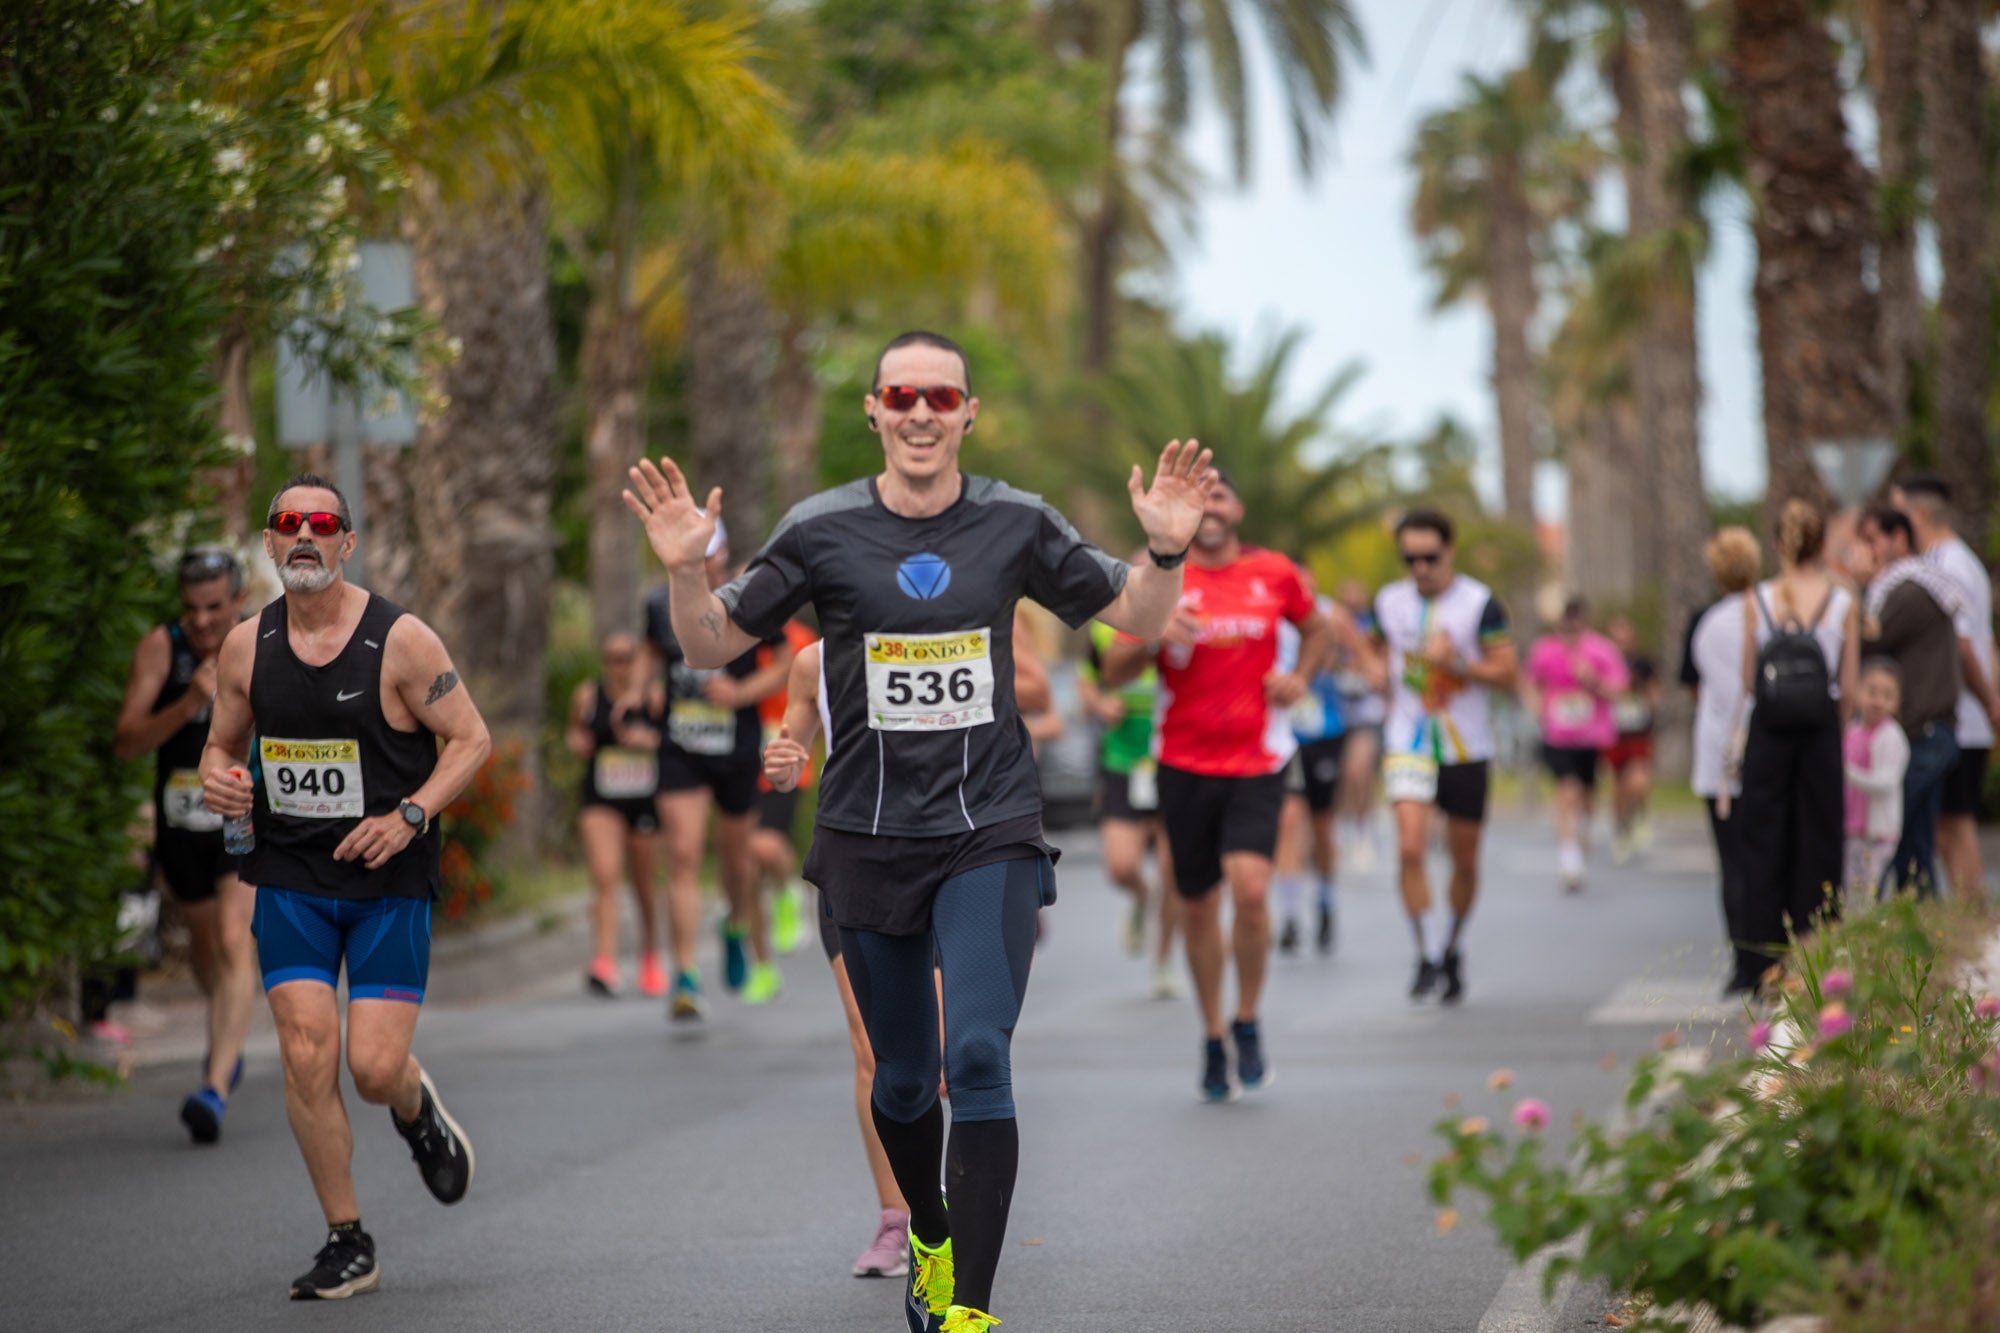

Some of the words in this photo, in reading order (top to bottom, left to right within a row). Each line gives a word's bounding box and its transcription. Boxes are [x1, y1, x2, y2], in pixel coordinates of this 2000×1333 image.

[883, 641, 904, 658] 38
[886, 667, 975, 706] 536
[273, 744, 288, 758] 38
[277, 767, 345, 797] 940
